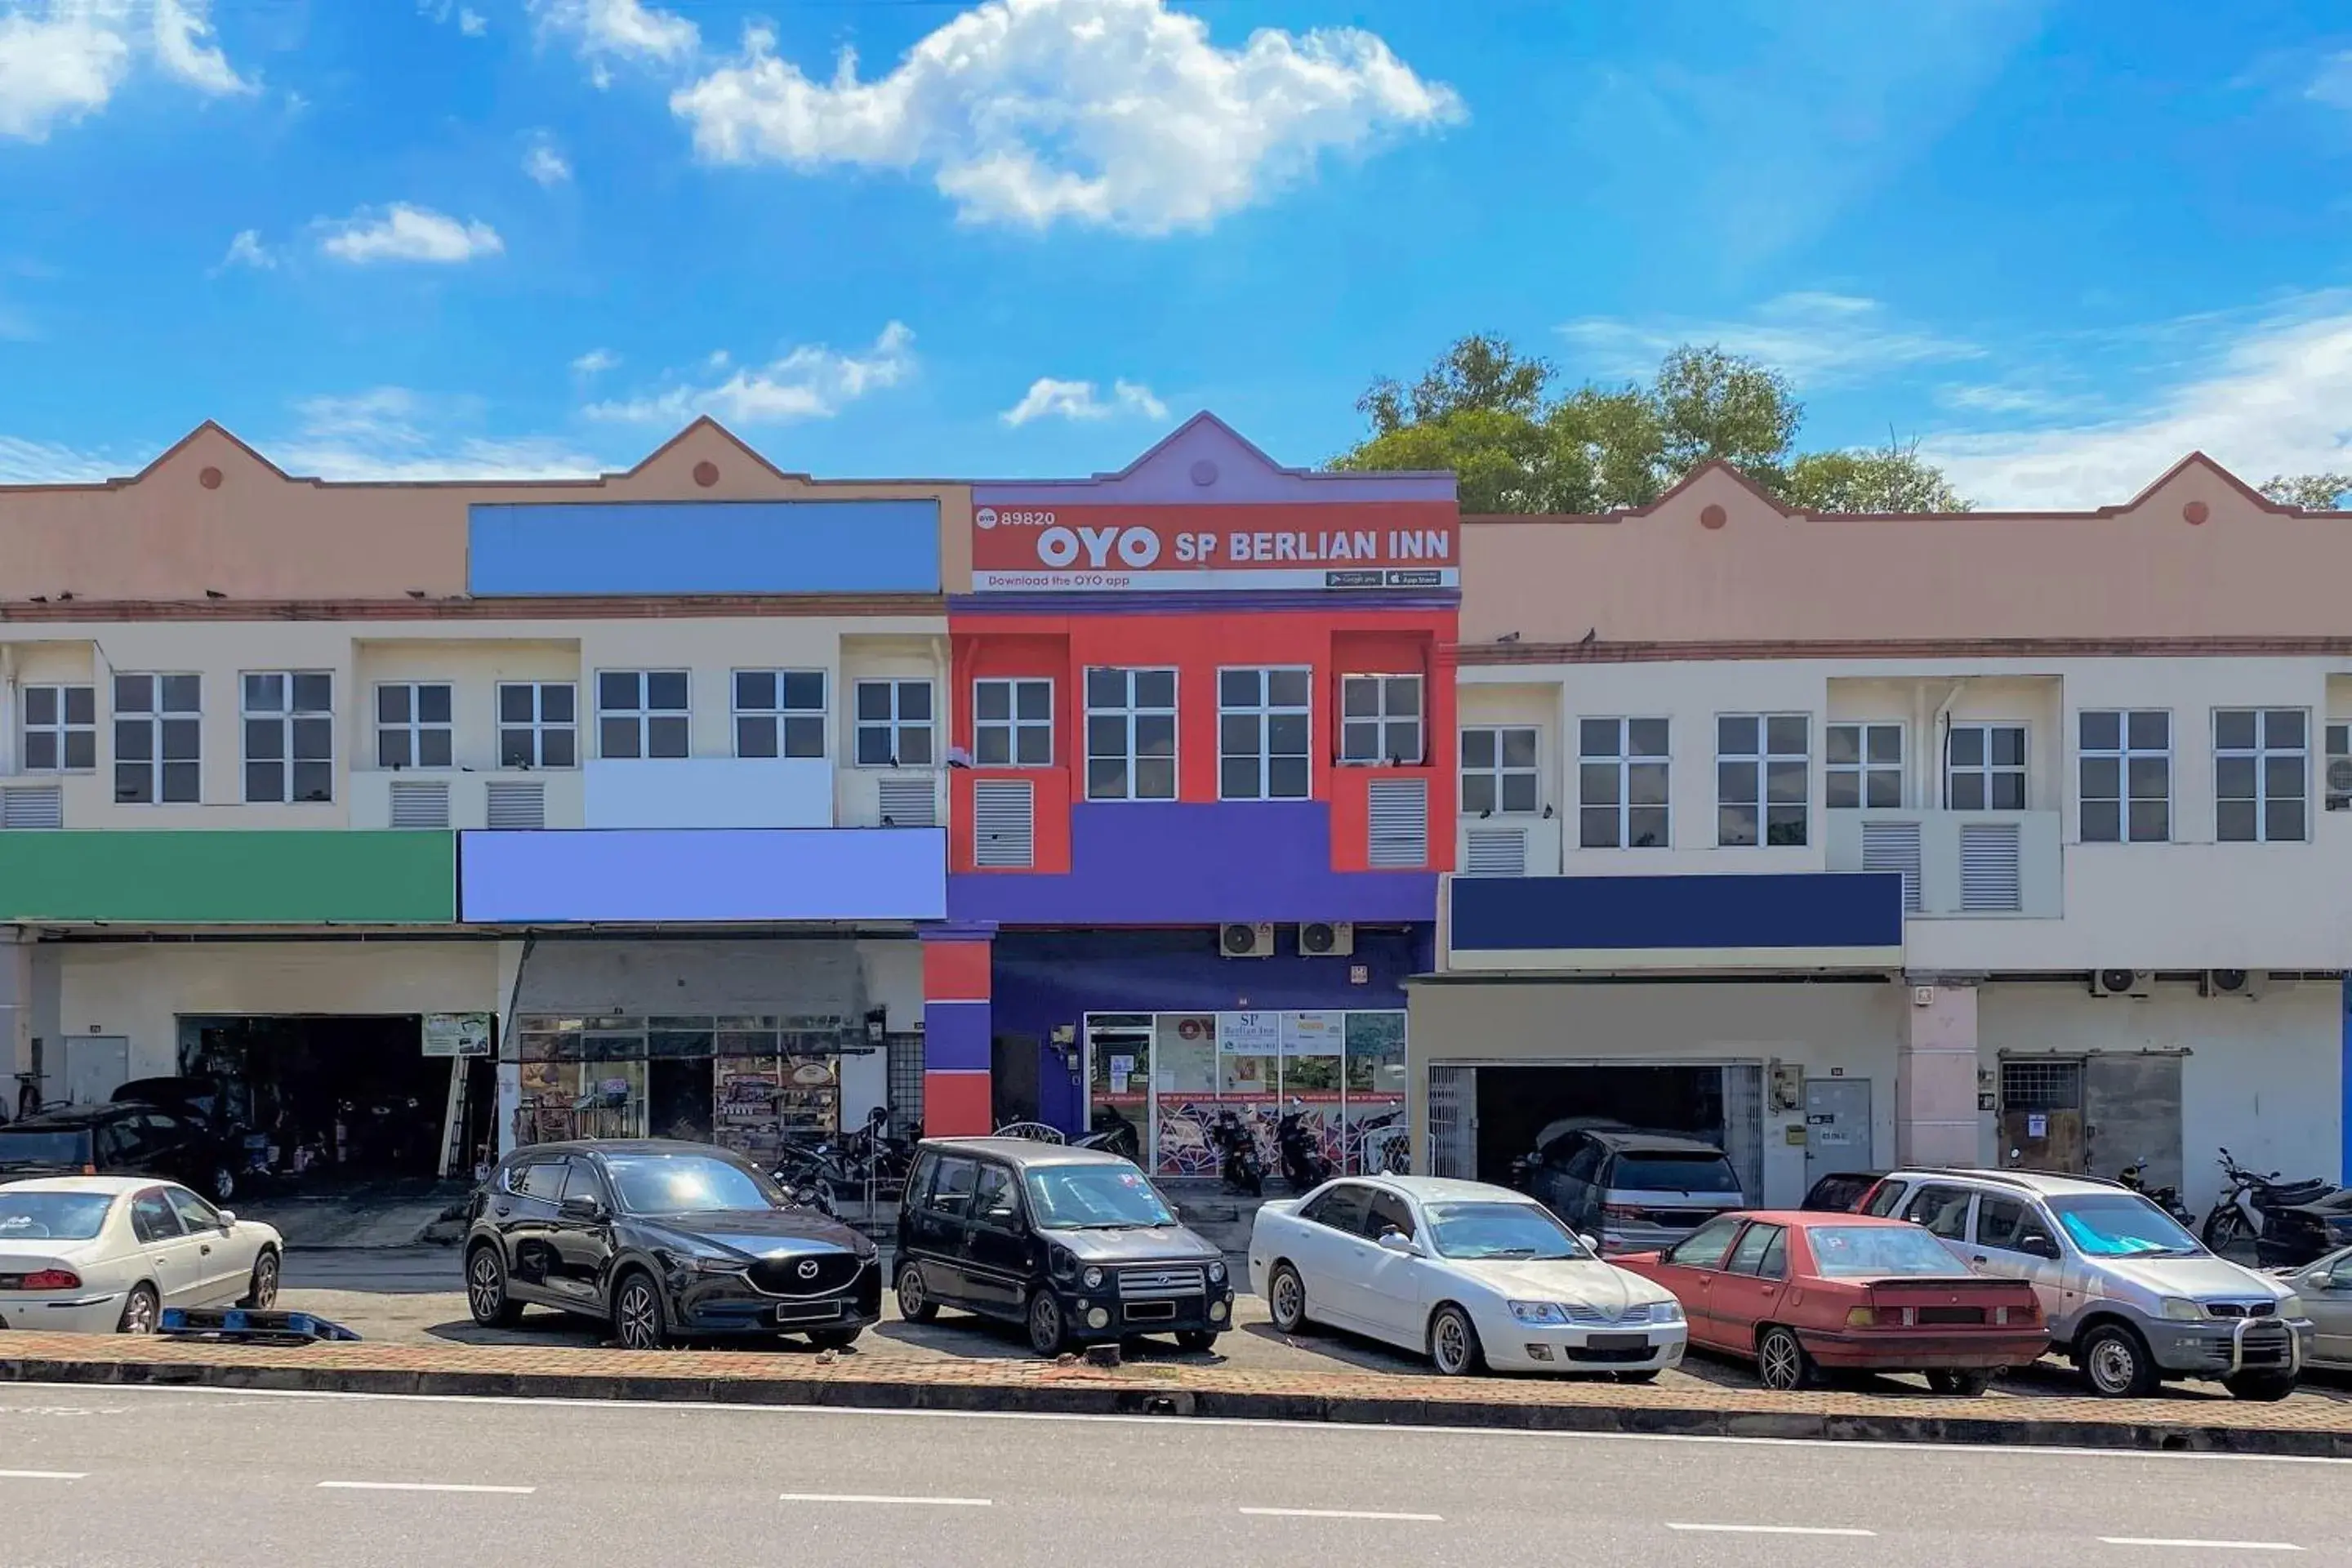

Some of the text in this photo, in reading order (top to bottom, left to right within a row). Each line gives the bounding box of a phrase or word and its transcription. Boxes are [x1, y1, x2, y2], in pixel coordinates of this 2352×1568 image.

[1001, 512, 1055, 524] 89820
[1036, 526, 1449, 568] OYO SP BERLIAN INN
[989, 575, 1130, 588] Download the OYO app
[1241, 1013, 1259, 1027] SP
